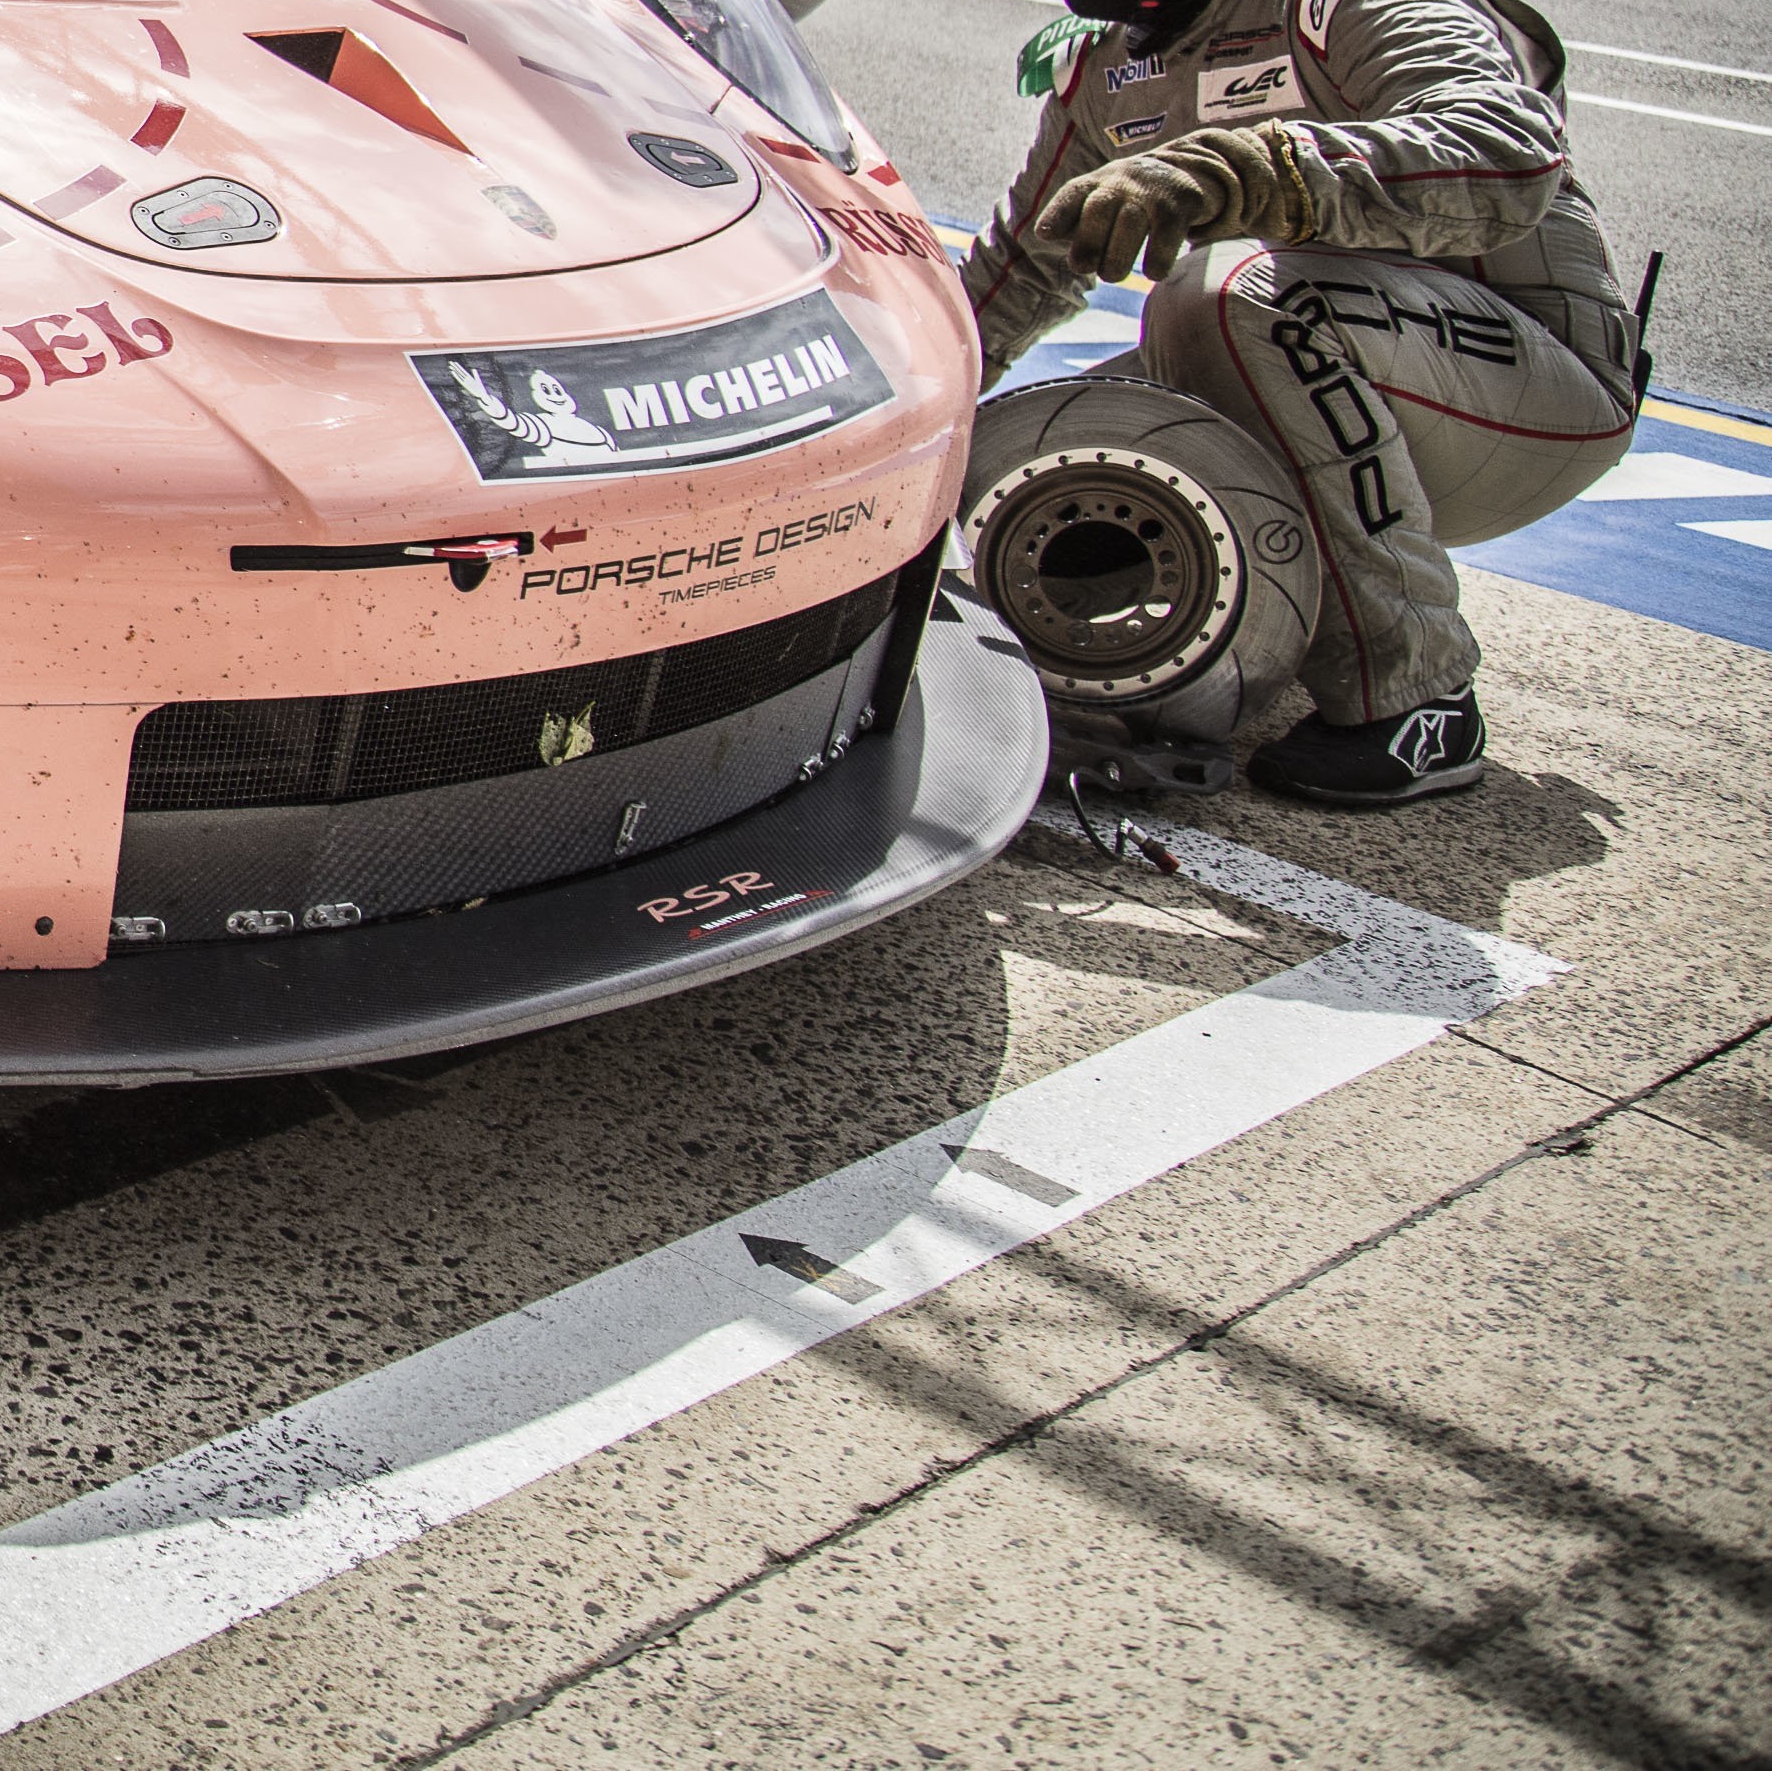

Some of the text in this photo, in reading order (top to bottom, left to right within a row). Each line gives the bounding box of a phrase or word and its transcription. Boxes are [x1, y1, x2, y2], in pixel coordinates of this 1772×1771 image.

[1224, 66, 1288, 97] WEC
[604, 332, 853, 432] MICHELIN
[520, 497, 877, 601] PORSCHE DESIGN
[659, 565, 778, 607] TIMEPIECES
[636, 871, 775, 924] RSR
